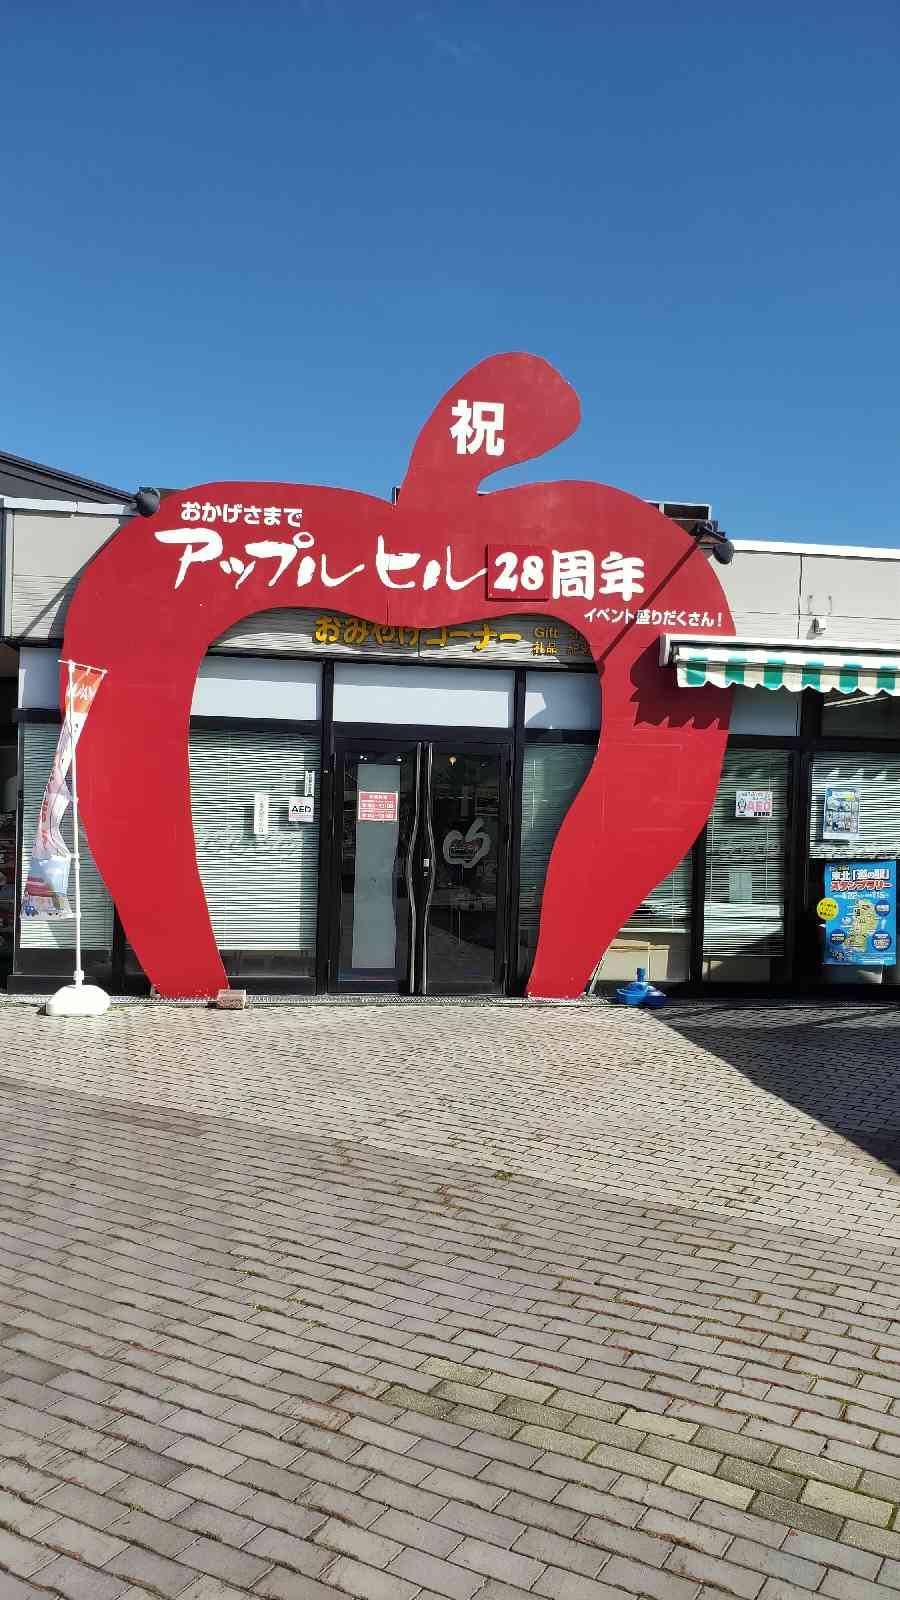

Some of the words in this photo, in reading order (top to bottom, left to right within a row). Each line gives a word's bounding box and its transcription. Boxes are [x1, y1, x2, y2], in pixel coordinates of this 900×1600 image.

[450, 399, 505, 456] 祝
[180, 501, 303, 527] おかげさまで
[291, 805, 312, 813] AED
